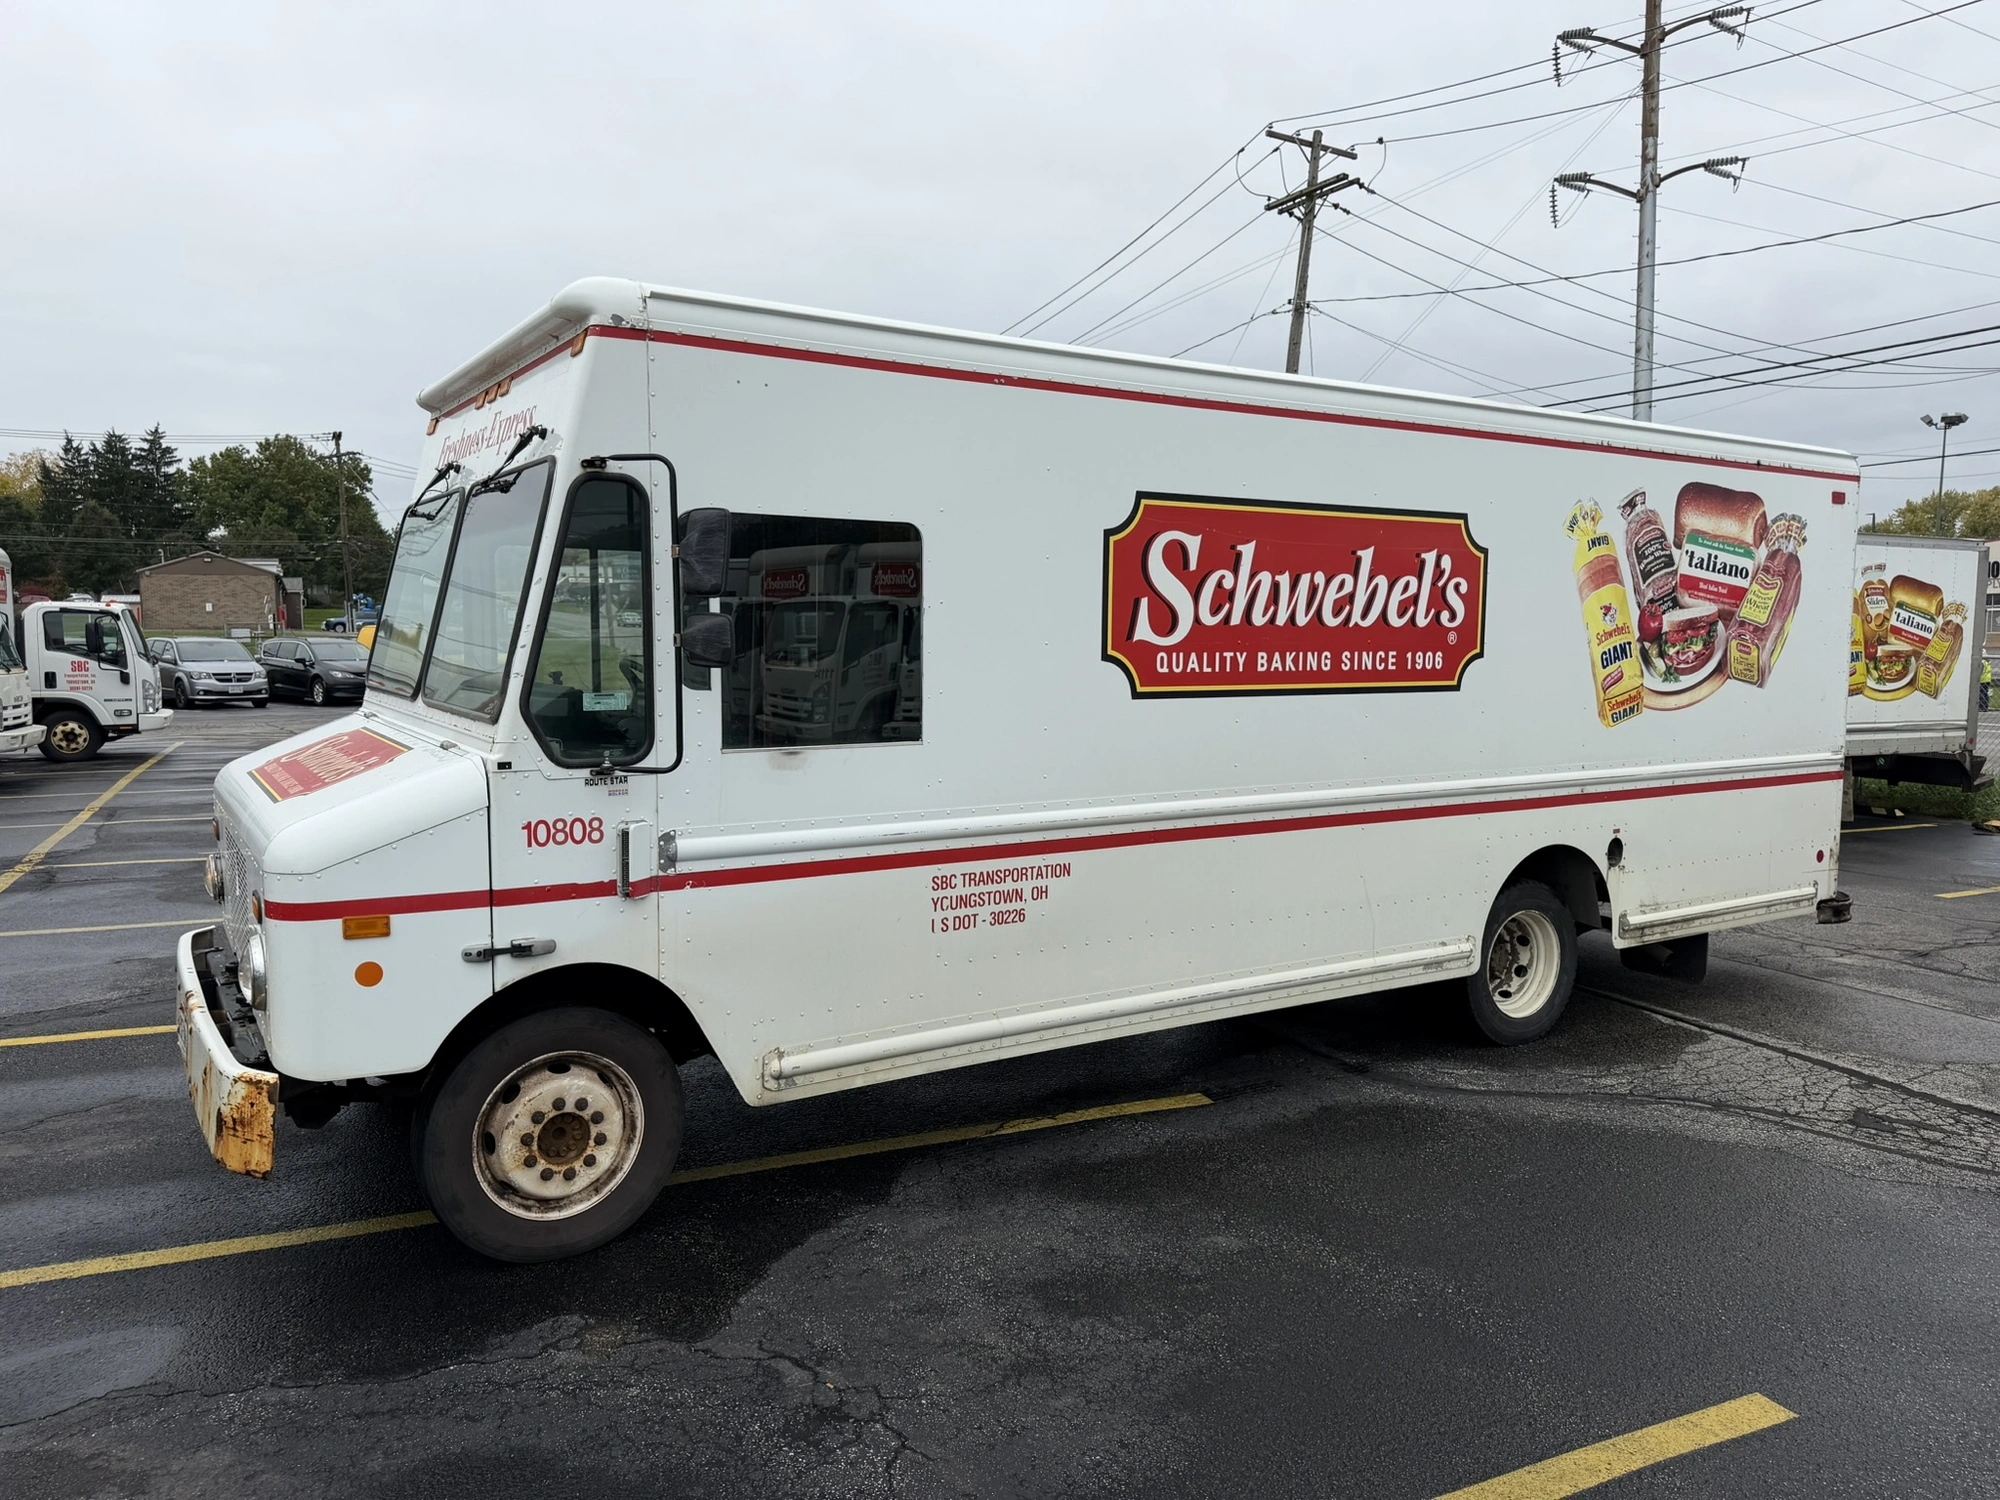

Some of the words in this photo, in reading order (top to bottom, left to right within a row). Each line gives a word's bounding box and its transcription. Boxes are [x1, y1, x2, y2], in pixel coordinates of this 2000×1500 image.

[1587, 535, 1610, 552] GIANT
[1685, 549, 1750, 580] 'taliano
[1130, 529, 1468, 647] Schwebel's
[1596, 622, 1631, 646] Schwebel's
[71, 660, 89, 672] SBC
[1156, 651, 1247, 673] QUALITY
[1256, 651, 1332, 672] BAKING
[1340, 650, 1397, 671] SINCE
[1405, 651, 1444, 670] 1906
[1600, 641, 1634, 670] GIANT
[1607, 690, 1642, 712] Schwebel's
[1611, 702, 1641, 724] GIANT
[584, 777, 608, 787] ROUTE
[610, 776, 629, 785] STAR
[521, 816, 605, 848] 10808
[931, 874, 957, 891] SBC
[960, 862, 1071, 888] TRANSPORTATION
[1031, 885, 1048, 901] OH
[953, 914, 979, 931] DOT
[989, 908, 1026, 927] 30226
